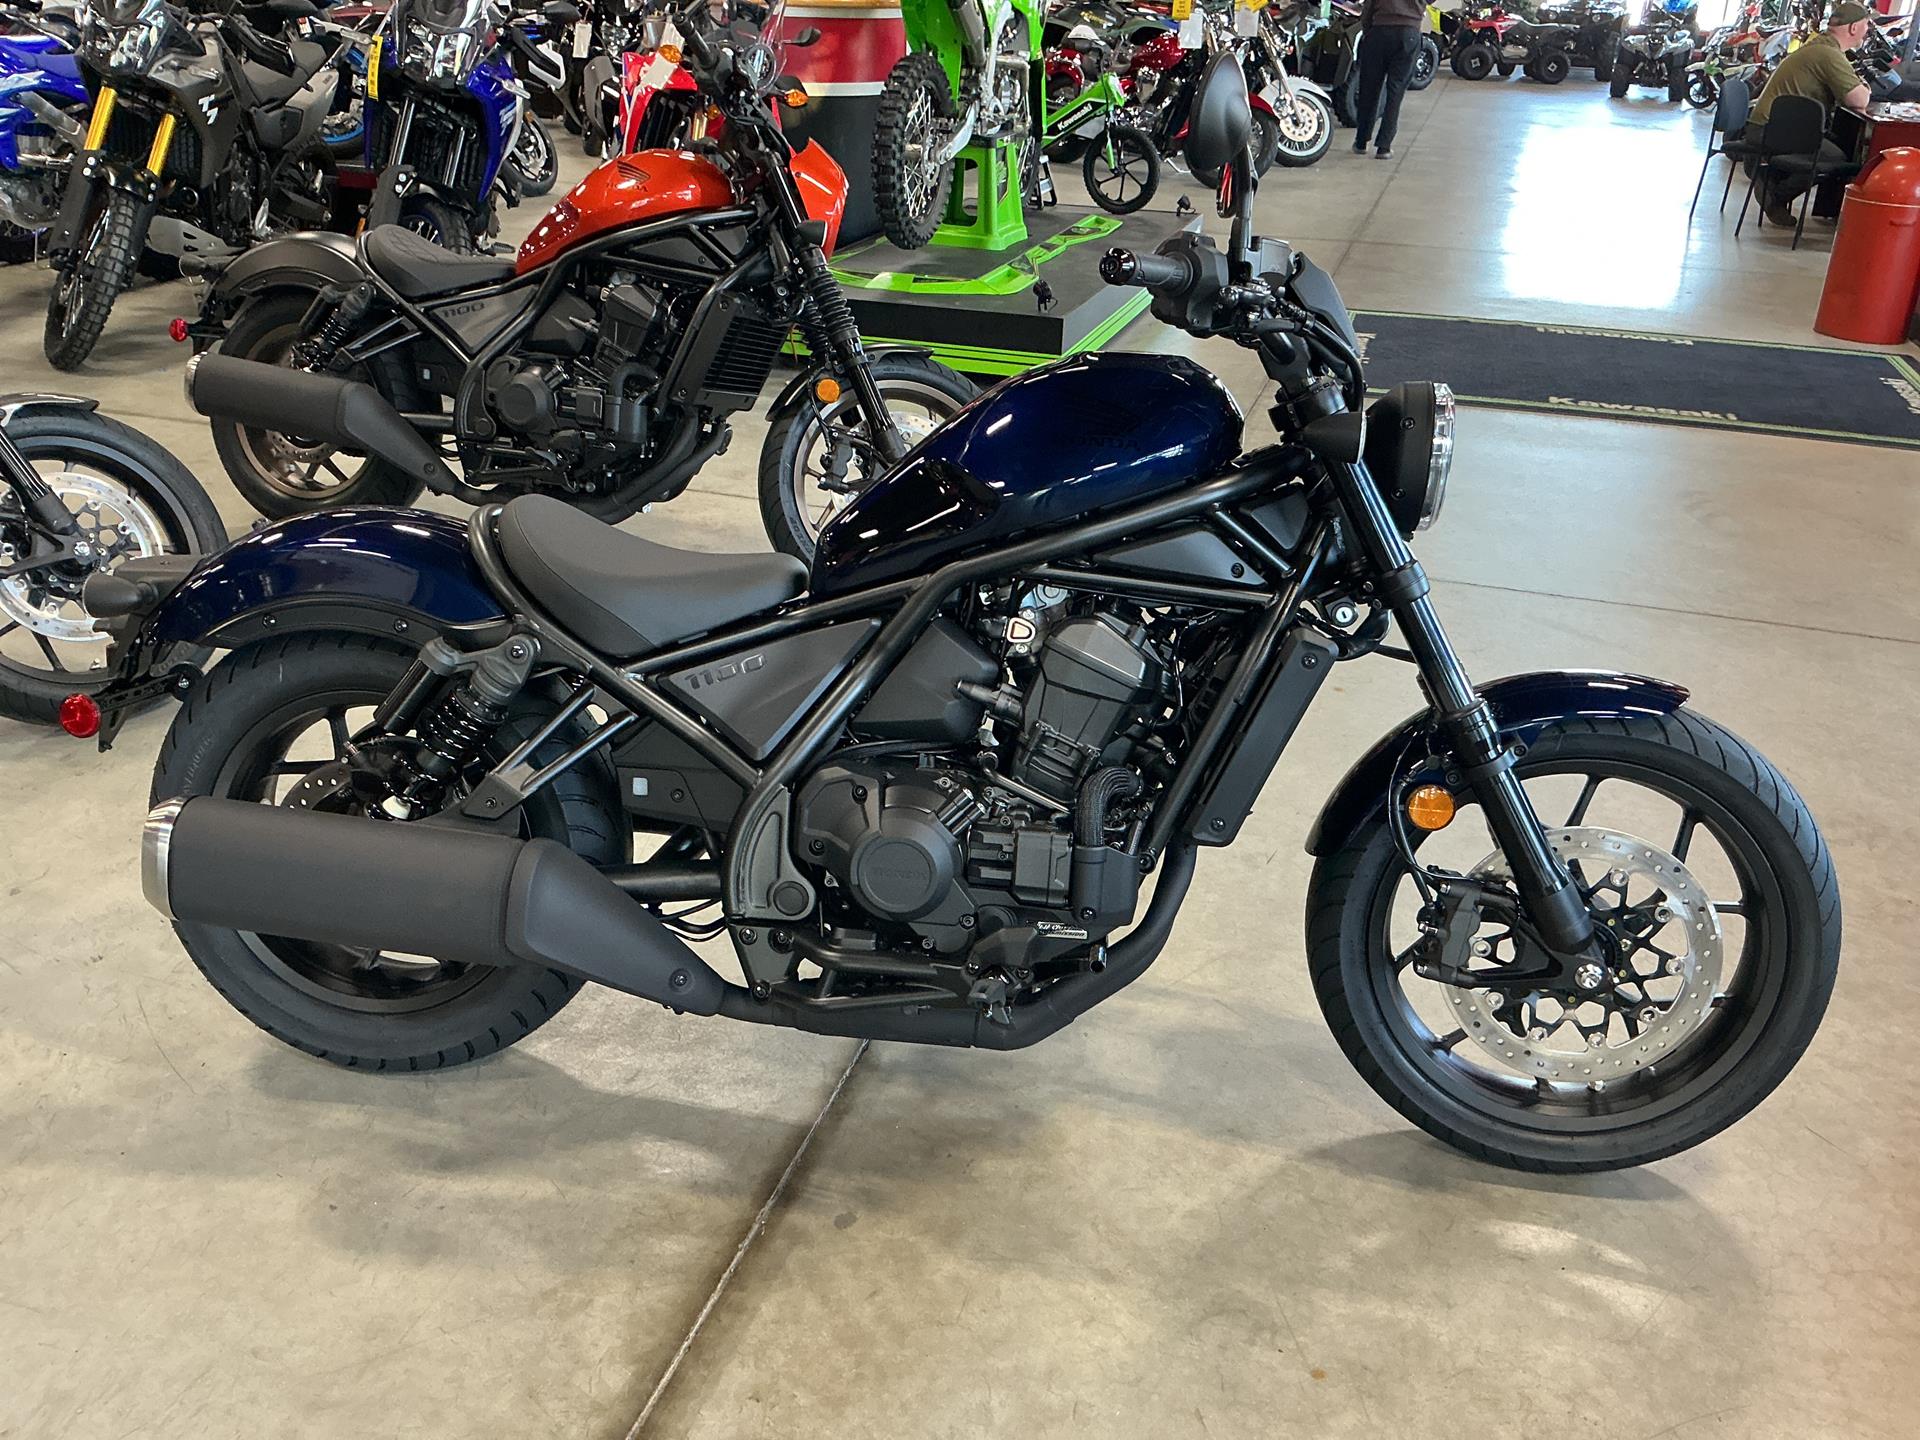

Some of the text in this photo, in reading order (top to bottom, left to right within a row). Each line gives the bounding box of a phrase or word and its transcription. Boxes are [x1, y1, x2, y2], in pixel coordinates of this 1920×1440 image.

[1057, 103, 1093, 130] Kawasaki
[443, 302, 485, 317] 1100
[1548, 396, 1738, 420] Kawasaki
[685, 653, 767, 690] 1100
